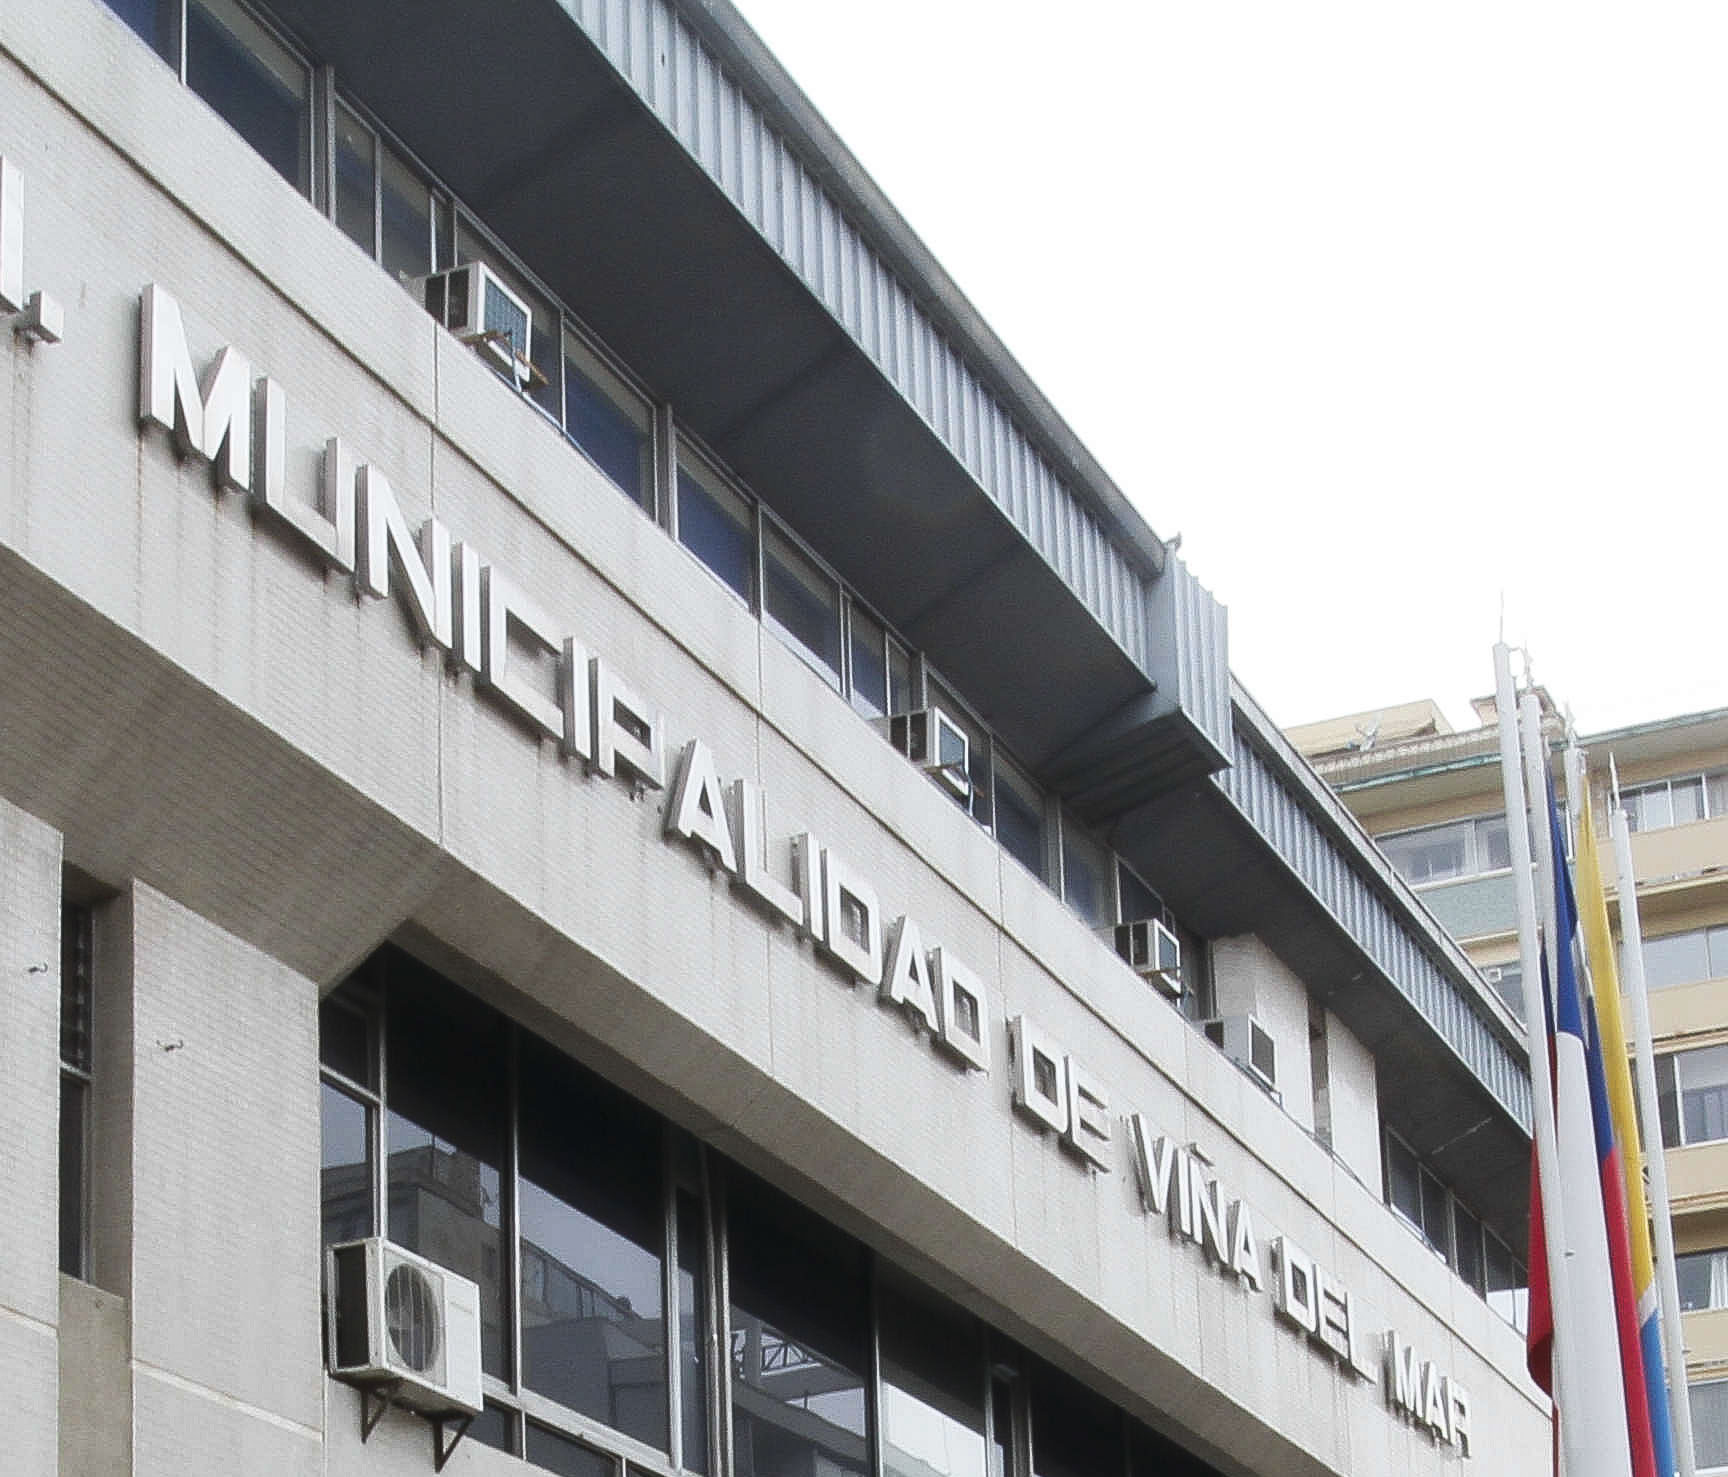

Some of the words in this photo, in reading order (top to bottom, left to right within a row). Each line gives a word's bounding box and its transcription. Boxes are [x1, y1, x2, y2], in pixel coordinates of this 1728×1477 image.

[140, 281, 991, 1073] MUNICIPALIDAD
[1007, 1014, 1110, 1174] DE
[1122, 1112, 1264, 1293] VIÑA
[1272, 1234, 1377, 1385] DEL
[1383, 1328, 1473, 1459] MAR
